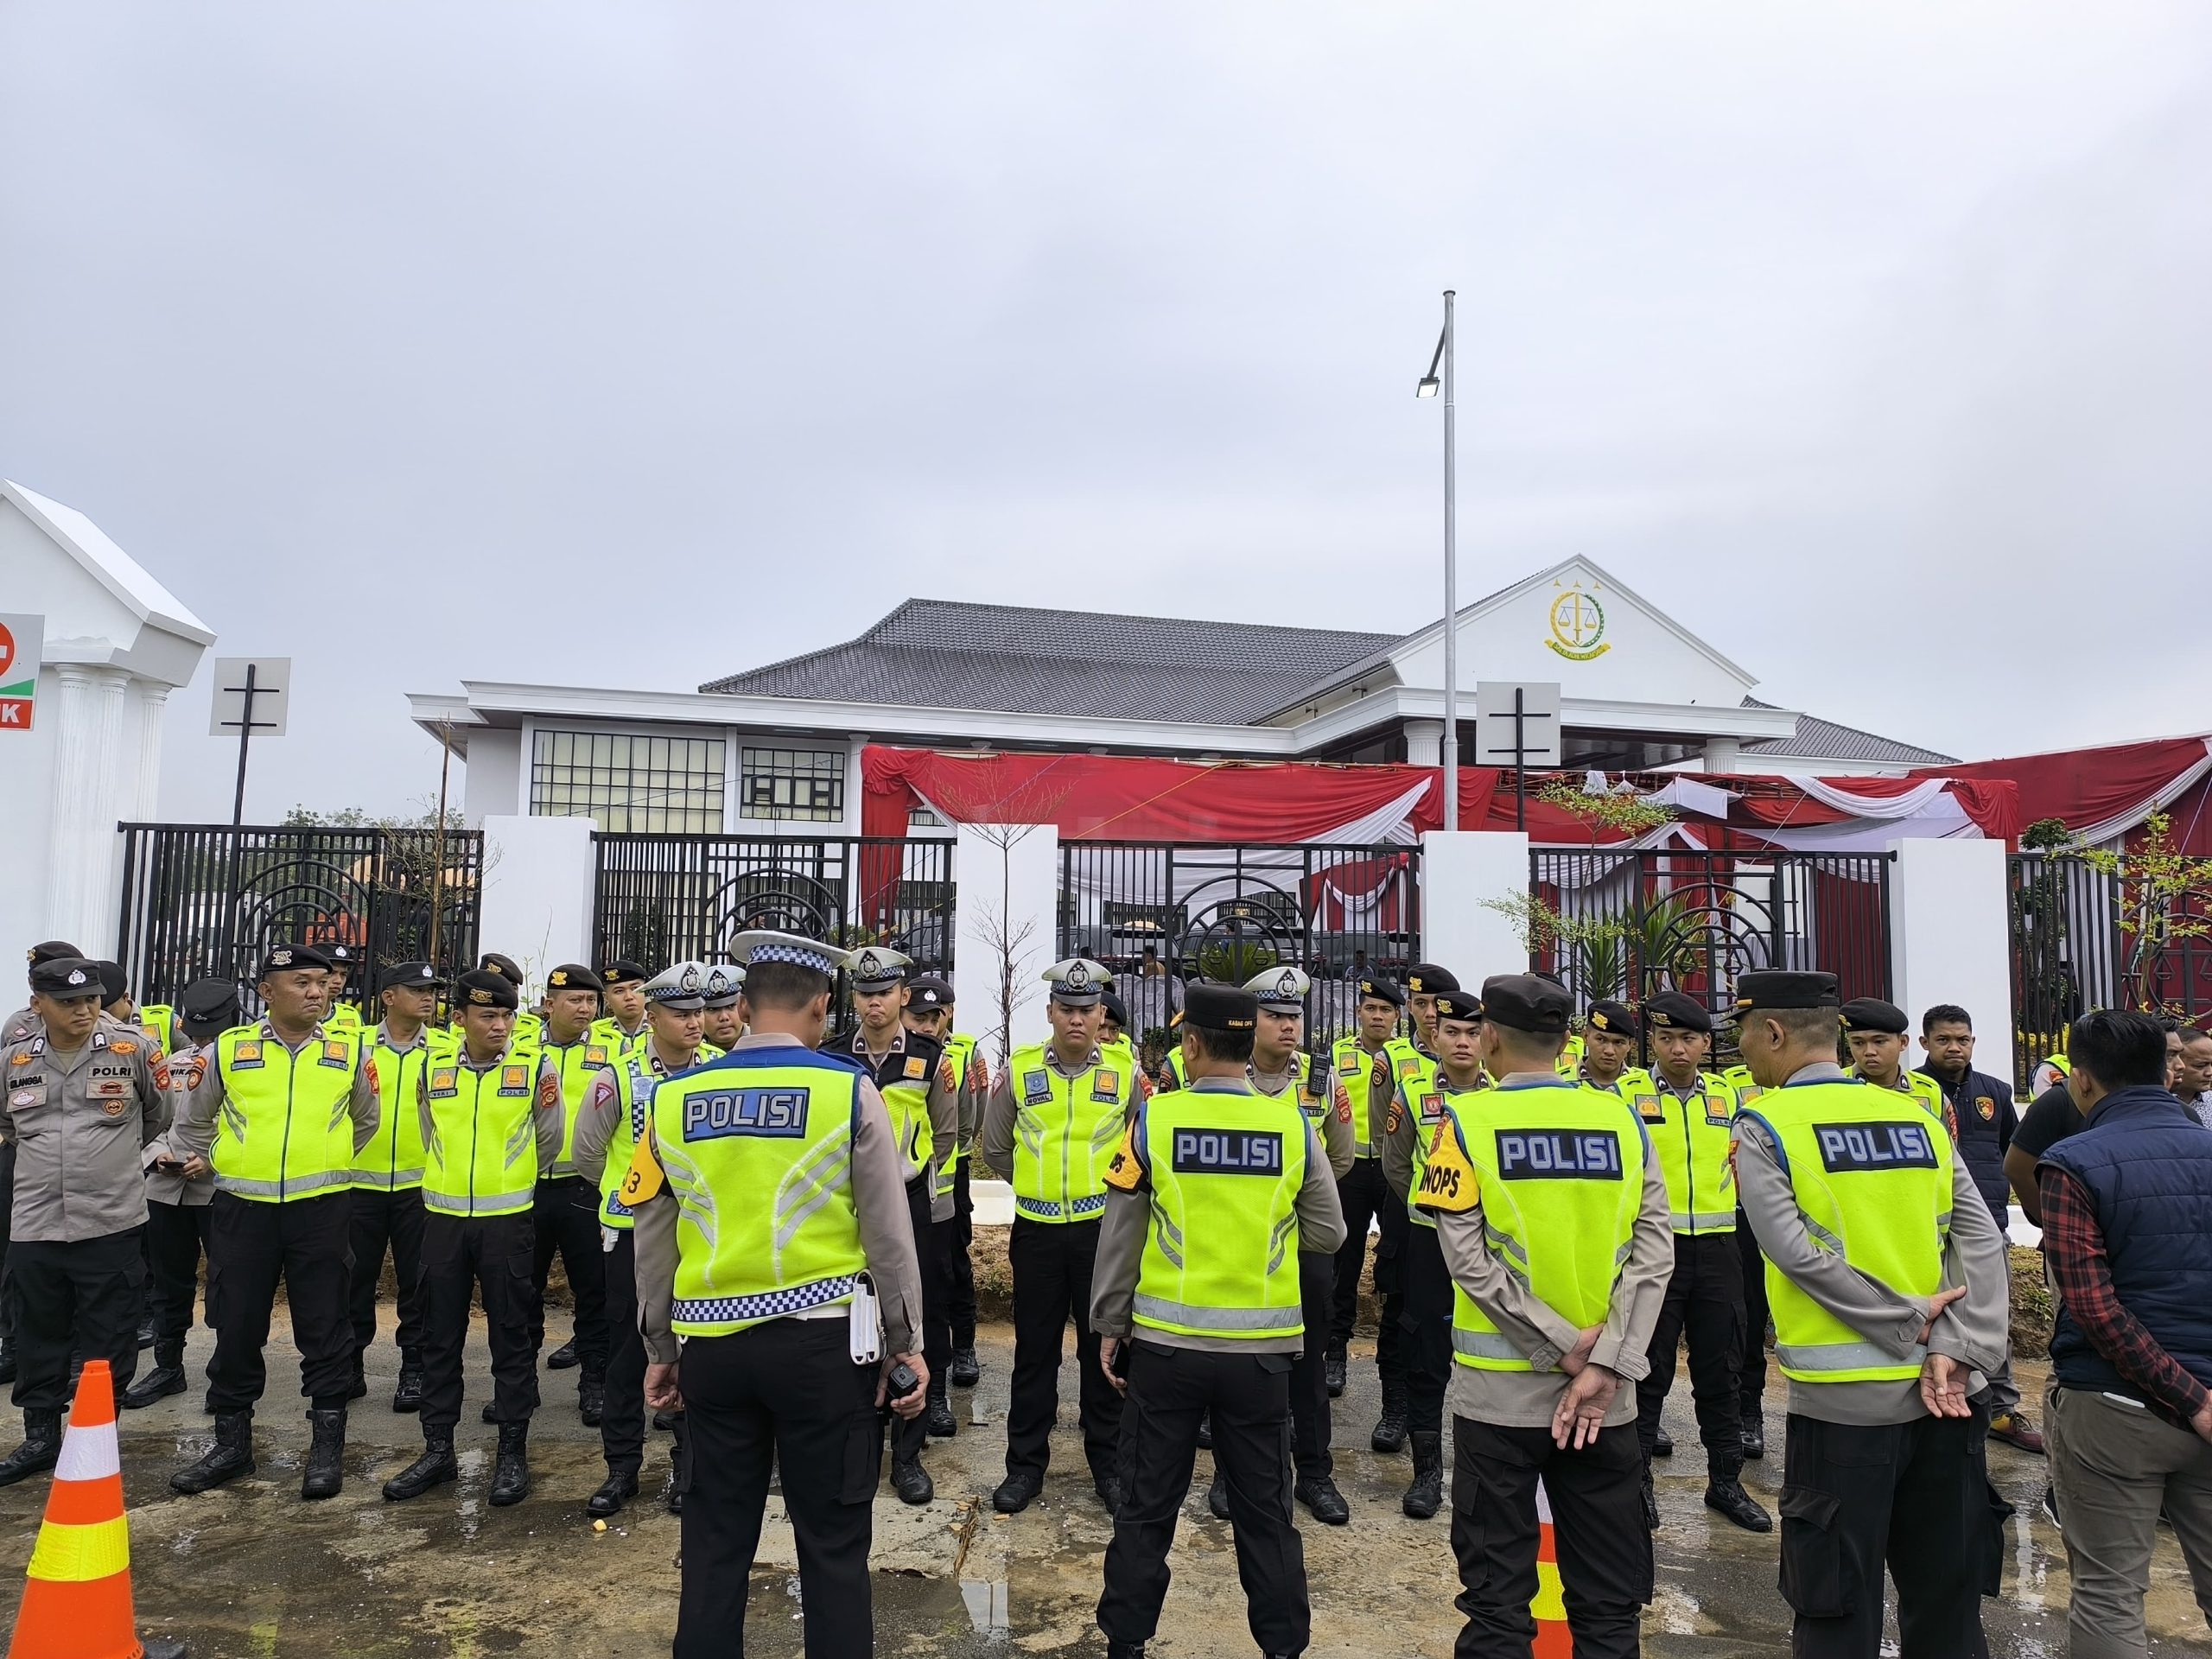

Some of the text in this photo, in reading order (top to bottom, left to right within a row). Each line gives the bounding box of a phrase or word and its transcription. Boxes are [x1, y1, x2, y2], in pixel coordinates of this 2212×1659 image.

[92, 1066, 131, 1077] POLRI
[686, 1095, 804, 1132] POLISI
[1027, 1095, 1050, 1104] NOVAL
[1176, 1134, 1279, 1168] POLISI
[1499, 1135, 1619, 1172] POLISI
[1819, 1127, 1934, 1162] POLISI
